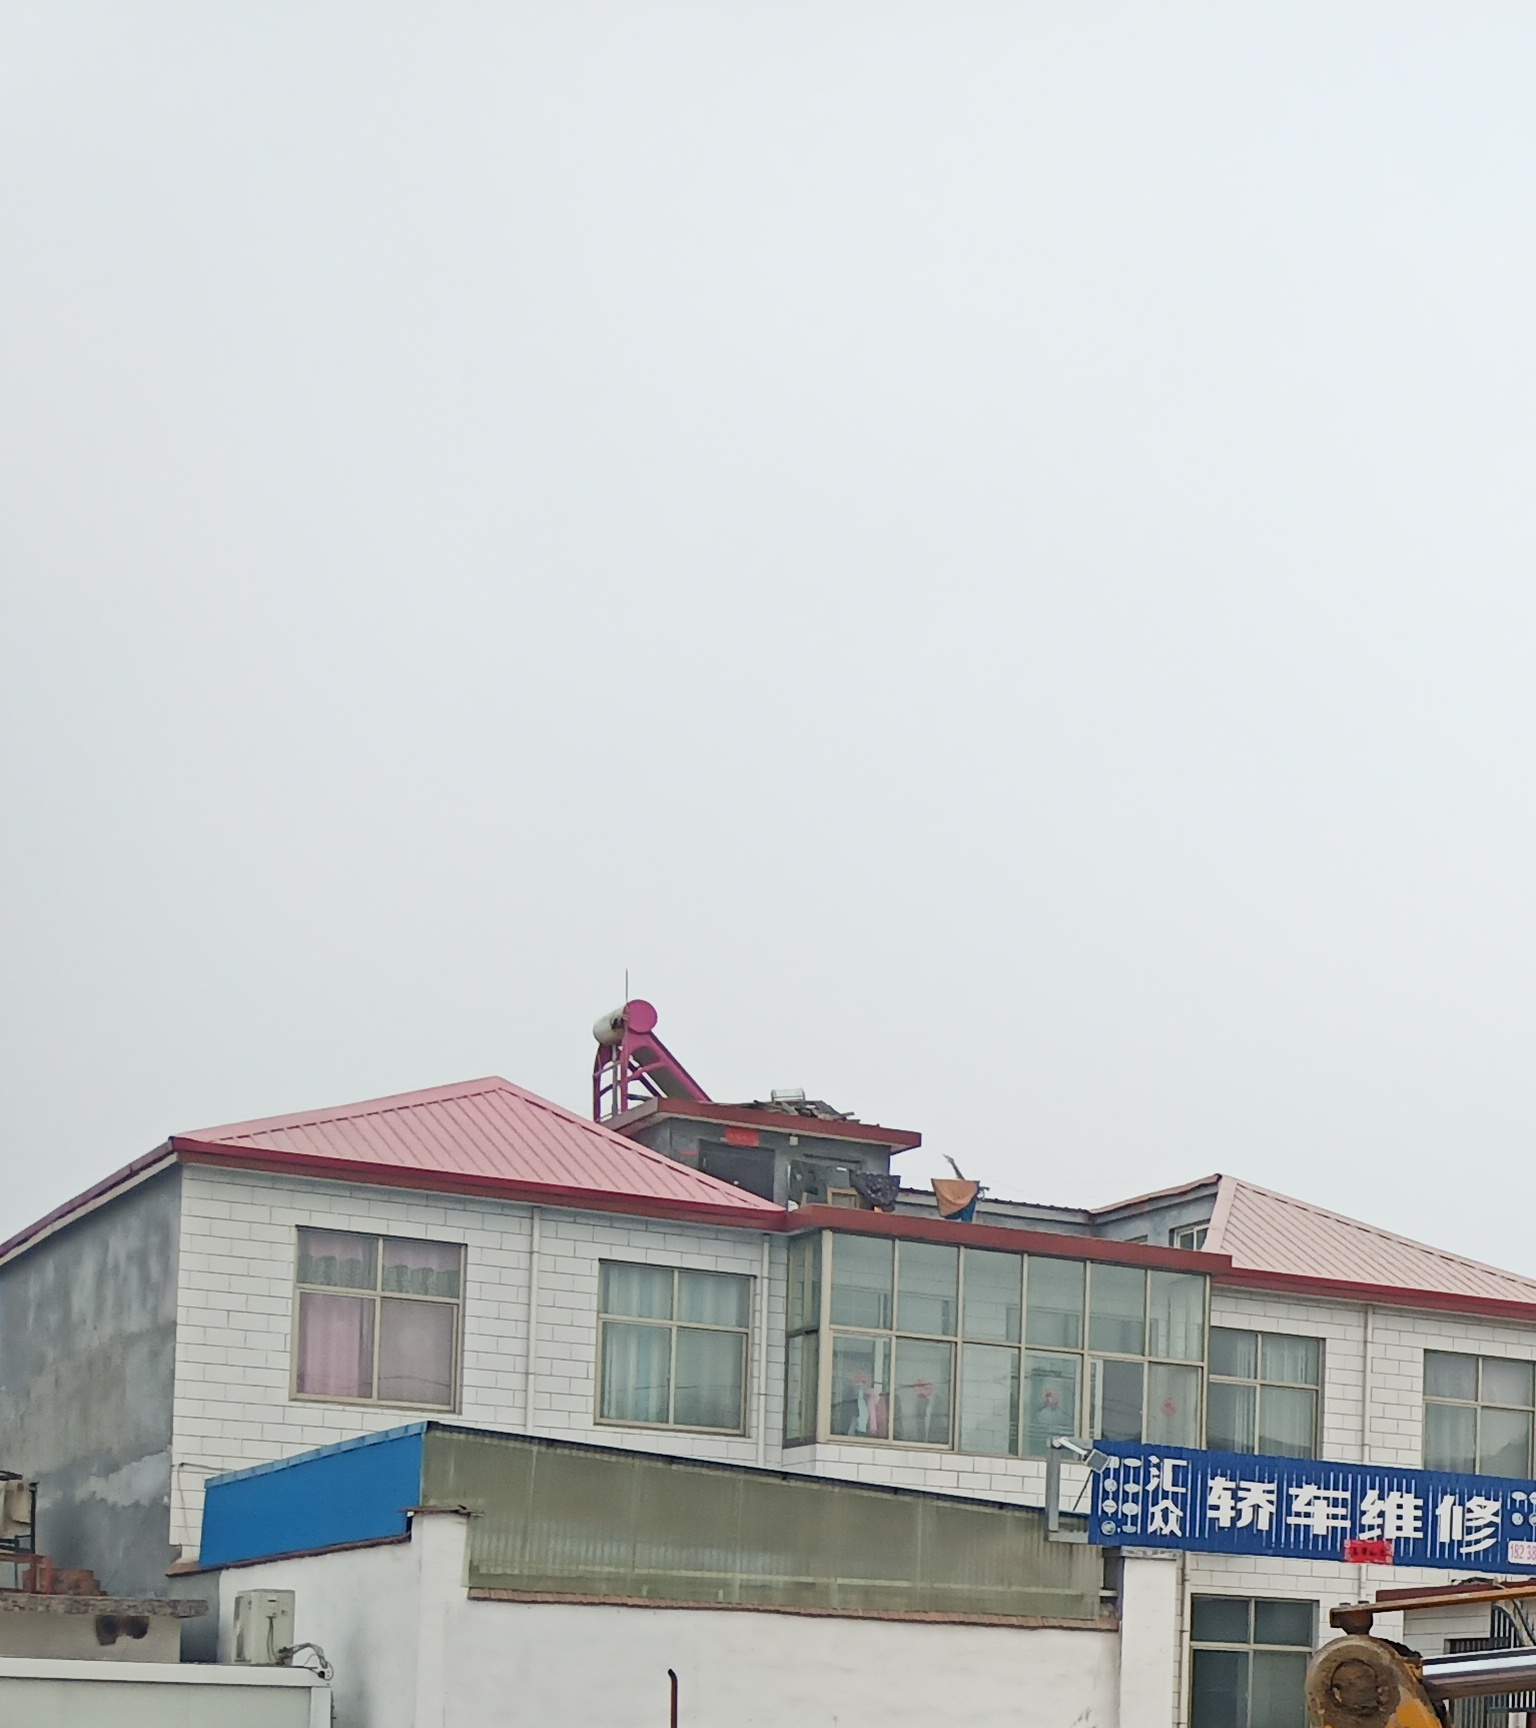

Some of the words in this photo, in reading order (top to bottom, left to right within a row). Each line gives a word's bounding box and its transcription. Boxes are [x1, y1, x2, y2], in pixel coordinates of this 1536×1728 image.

[1145, 1456, 1187, 1537] 汇众
[1207, 1476, 1501, 1553] 轿车维修
